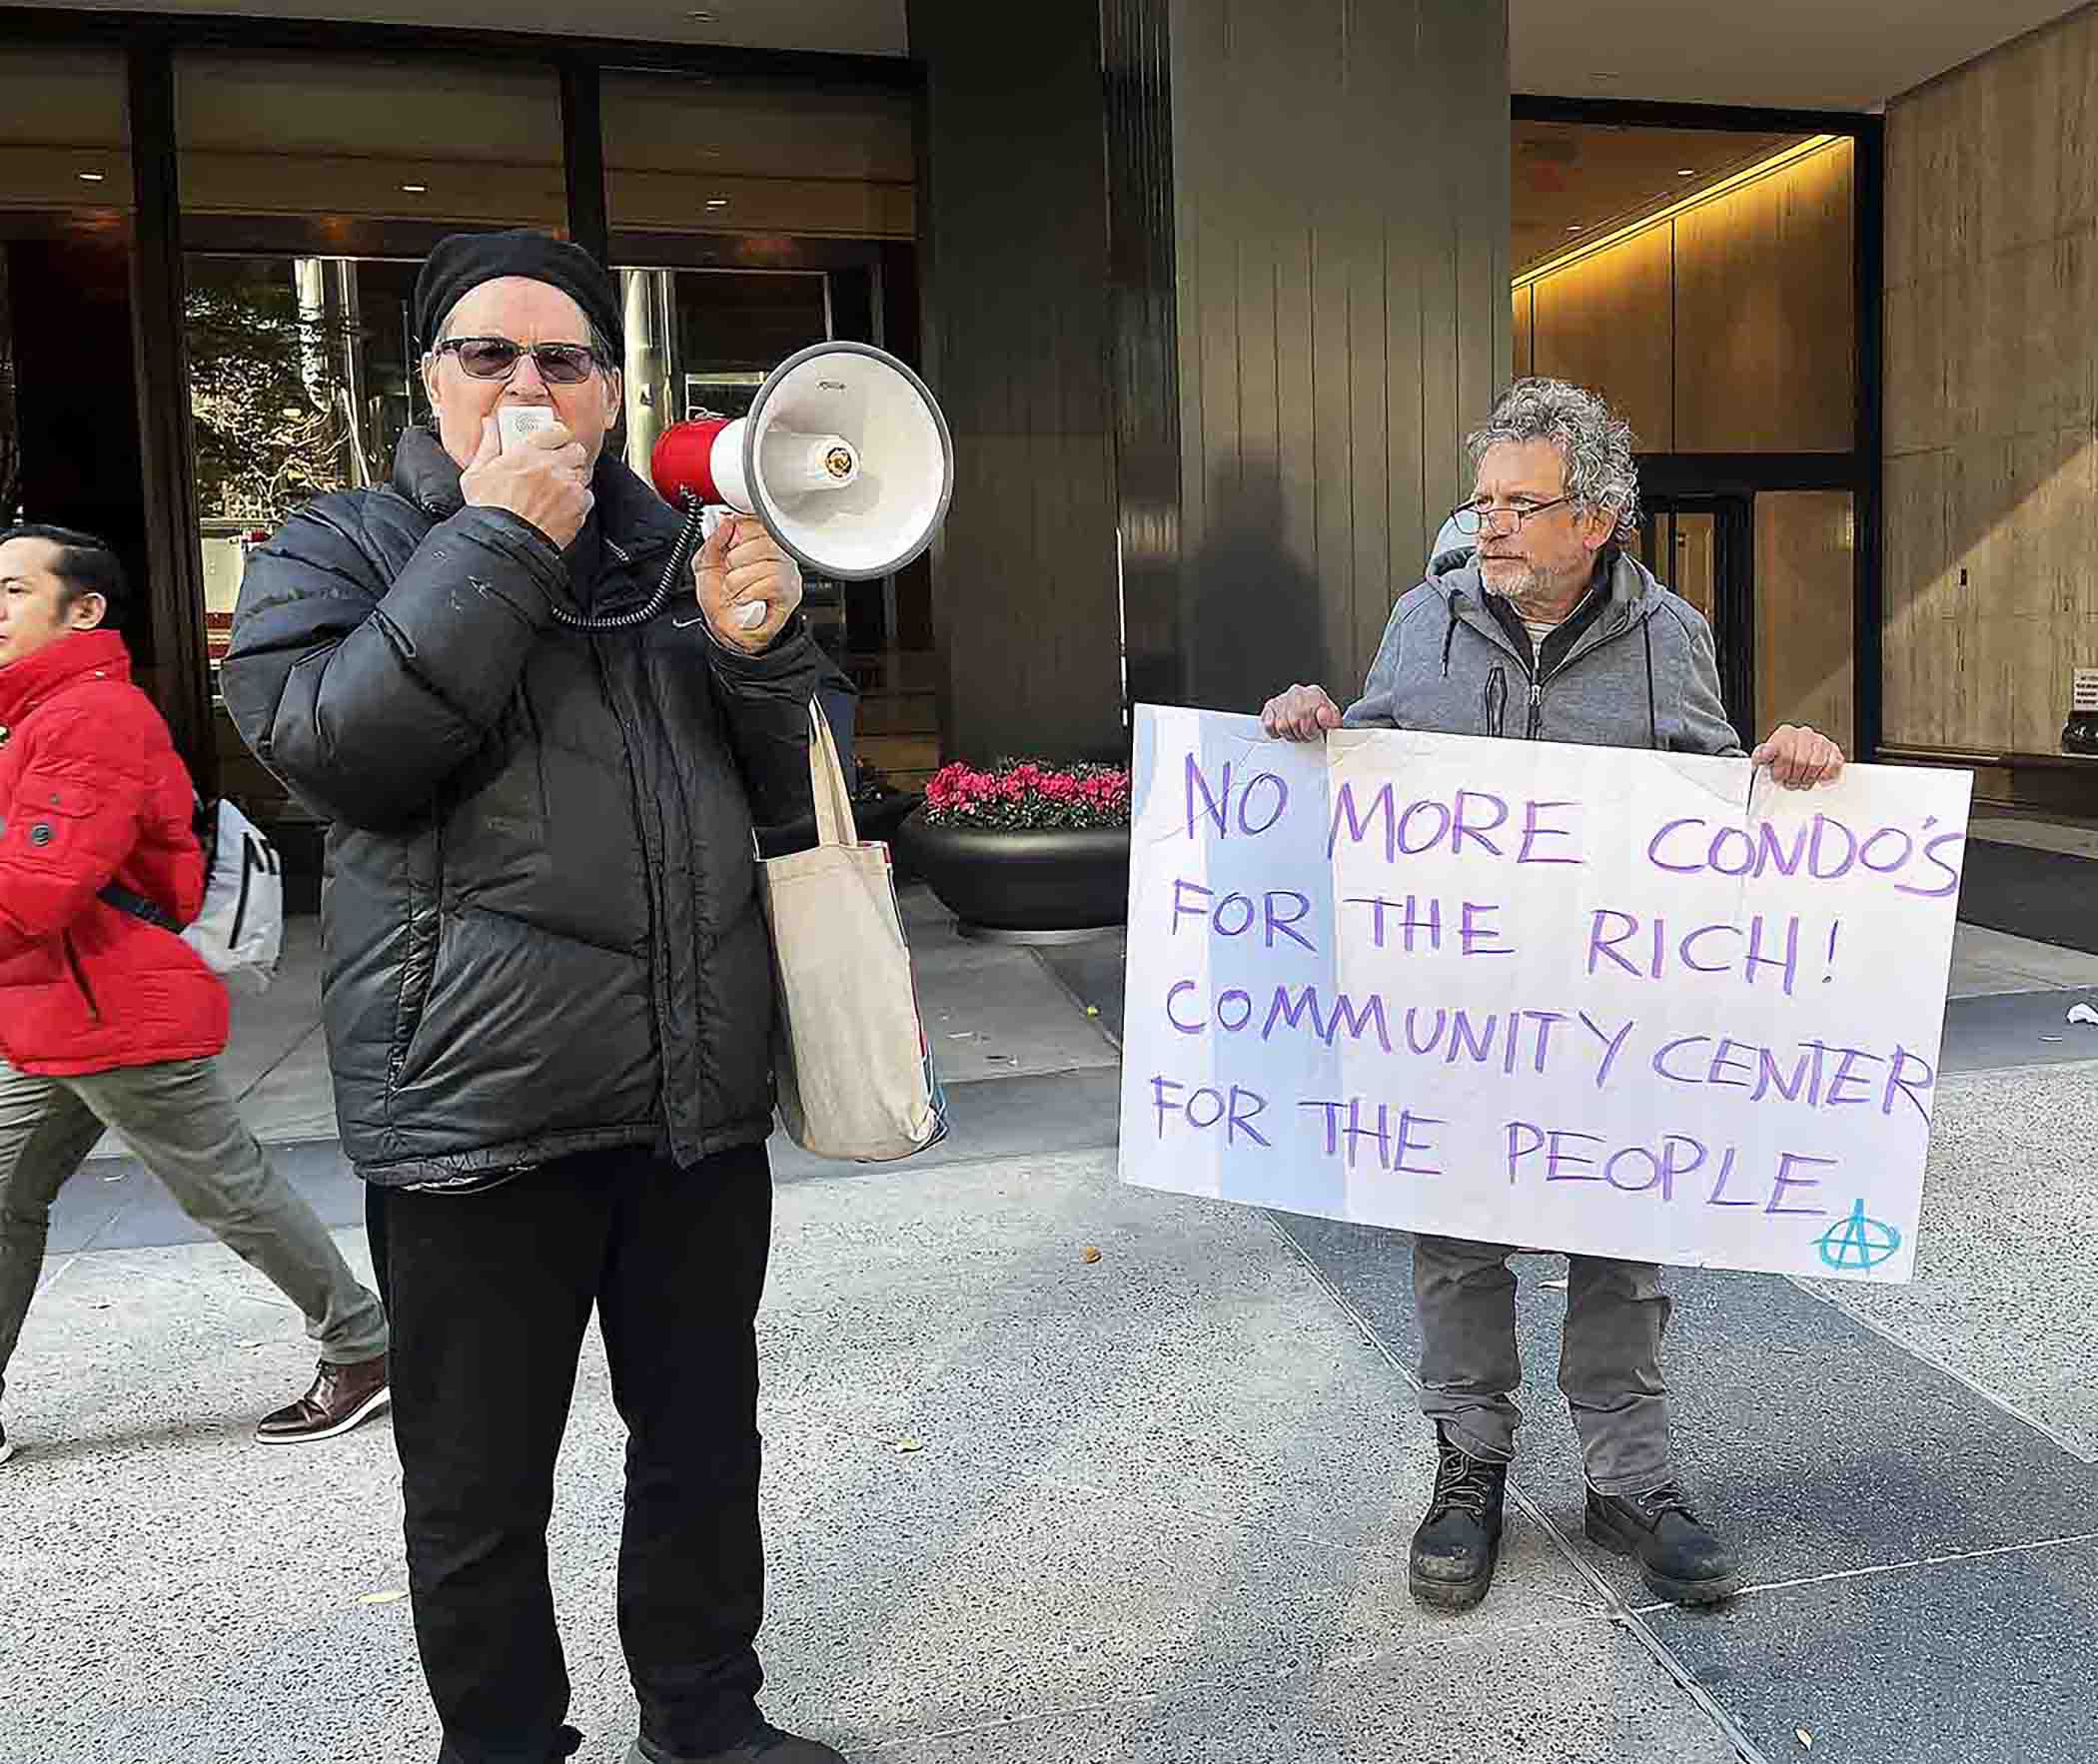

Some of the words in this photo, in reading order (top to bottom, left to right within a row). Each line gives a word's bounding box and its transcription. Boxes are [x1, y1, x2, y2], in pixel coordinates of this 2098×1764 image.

[1186, 752, 1289, 840] NO
[1327, 783, 1583, 864] MORE
[1648, 813, 1965, 897] CONDO'S
[1173, 878, 1318, 953] FOR
[1343, 895, 1515, 956] THE
[1166, 980, 1633, 1089] COMMUNITY
[1653, 1036, 1933, 1126] CENTER
[1151, 1076, 1272, 1147] FOR
[1298, 1098, 1449, 1175] THE
[1504, 1122, 1838, 1215] PEOPLE
